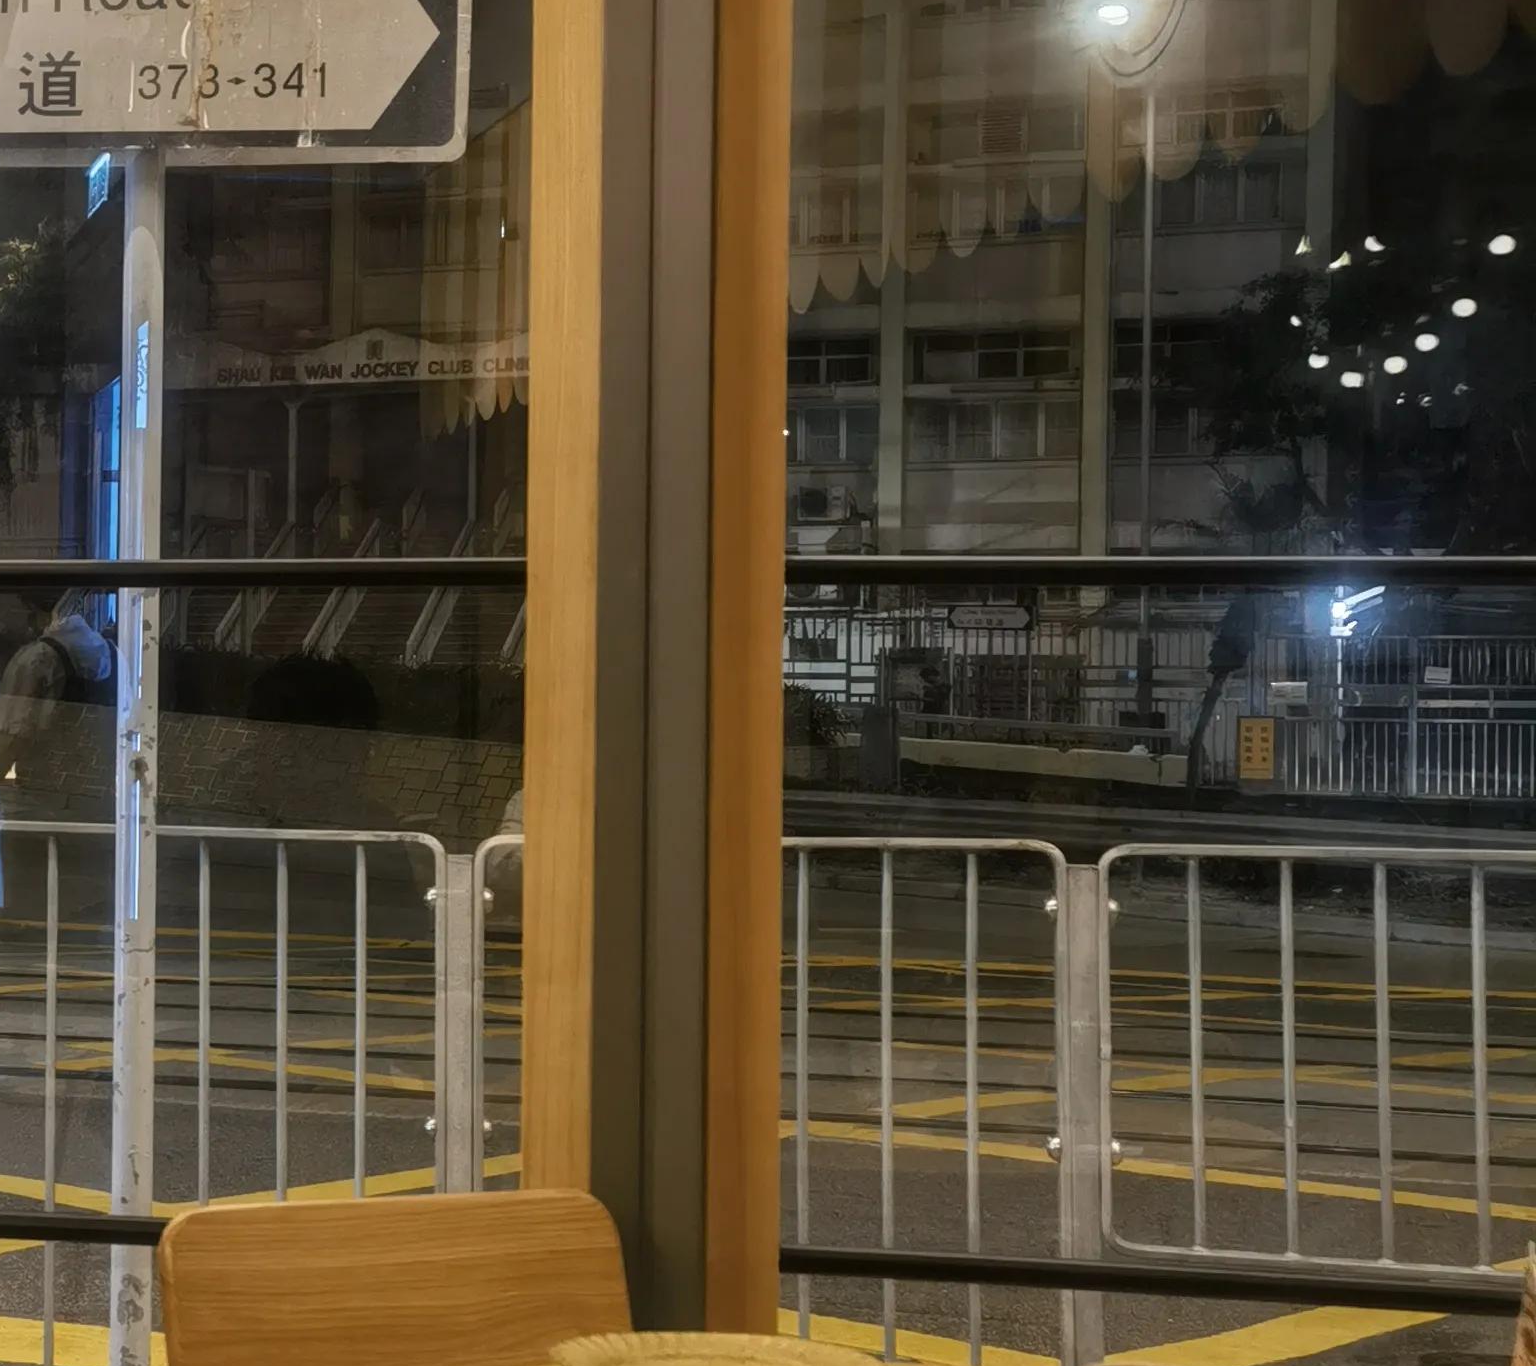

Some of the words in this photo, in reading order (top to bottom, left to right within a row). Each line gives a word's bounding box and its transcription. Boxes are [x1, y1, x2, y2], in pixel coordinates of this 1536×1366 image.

[138, 62, 327, 100] 373-341
[305, 362, 343, 380] WAN
[351, 361, 419, 379] JOCKEY
[427, 359, 473, 375] CLUB
